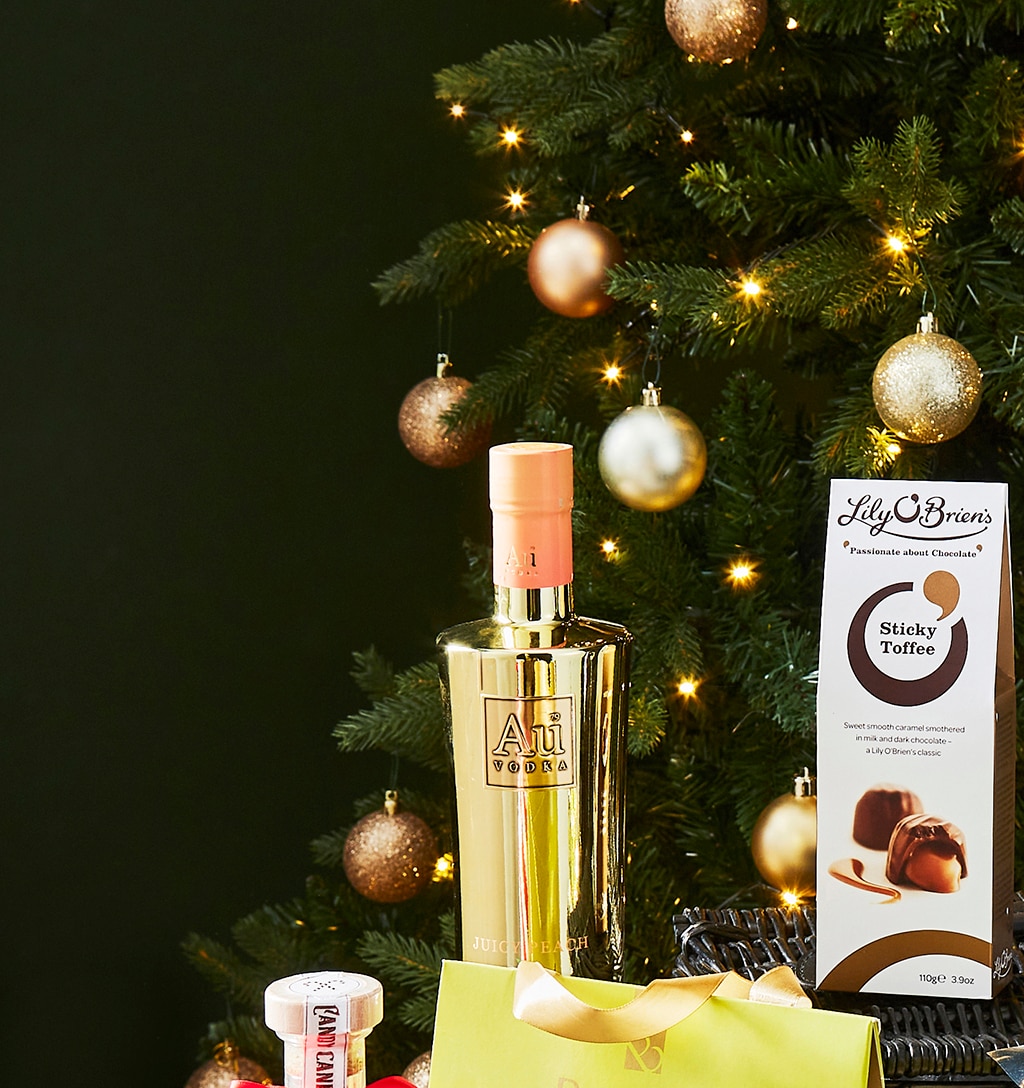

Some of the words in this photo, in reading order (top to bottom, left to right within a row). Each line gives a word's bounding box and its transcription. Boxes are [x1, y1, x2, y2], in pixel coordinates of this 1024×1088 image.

[837, 494, 894, 536] Lily
[850, 547, 900, 557] Passionate
[903, 548, 929, 558] about
[931, 549, 976, 559] Chocolate
[879, 622, 937, 640] Sticky
[879, 641, 936, 656] Toffee
[844, 722, 865, 730] Sweet
[867, 723, 894, 731] smooth
[895, 724, 924, 732] caramel
[925, 725, 965, 733] smothered
[879, 735, 893, 743] and
[894, 735, 909, 743] dark
[910, 736, 946, 745] chocolate
[871, 747, 883, 755] Lily
[884, 747, 917, 756] O'Brien's
[917, 748, 941, 757] classic
[492, 760, 568, 774] VODKA
[473, 936, 520, 953] JUICY
[951, 975, 975, 985] 3.9oz
[313, 1005, 340, 1049] CANDY
